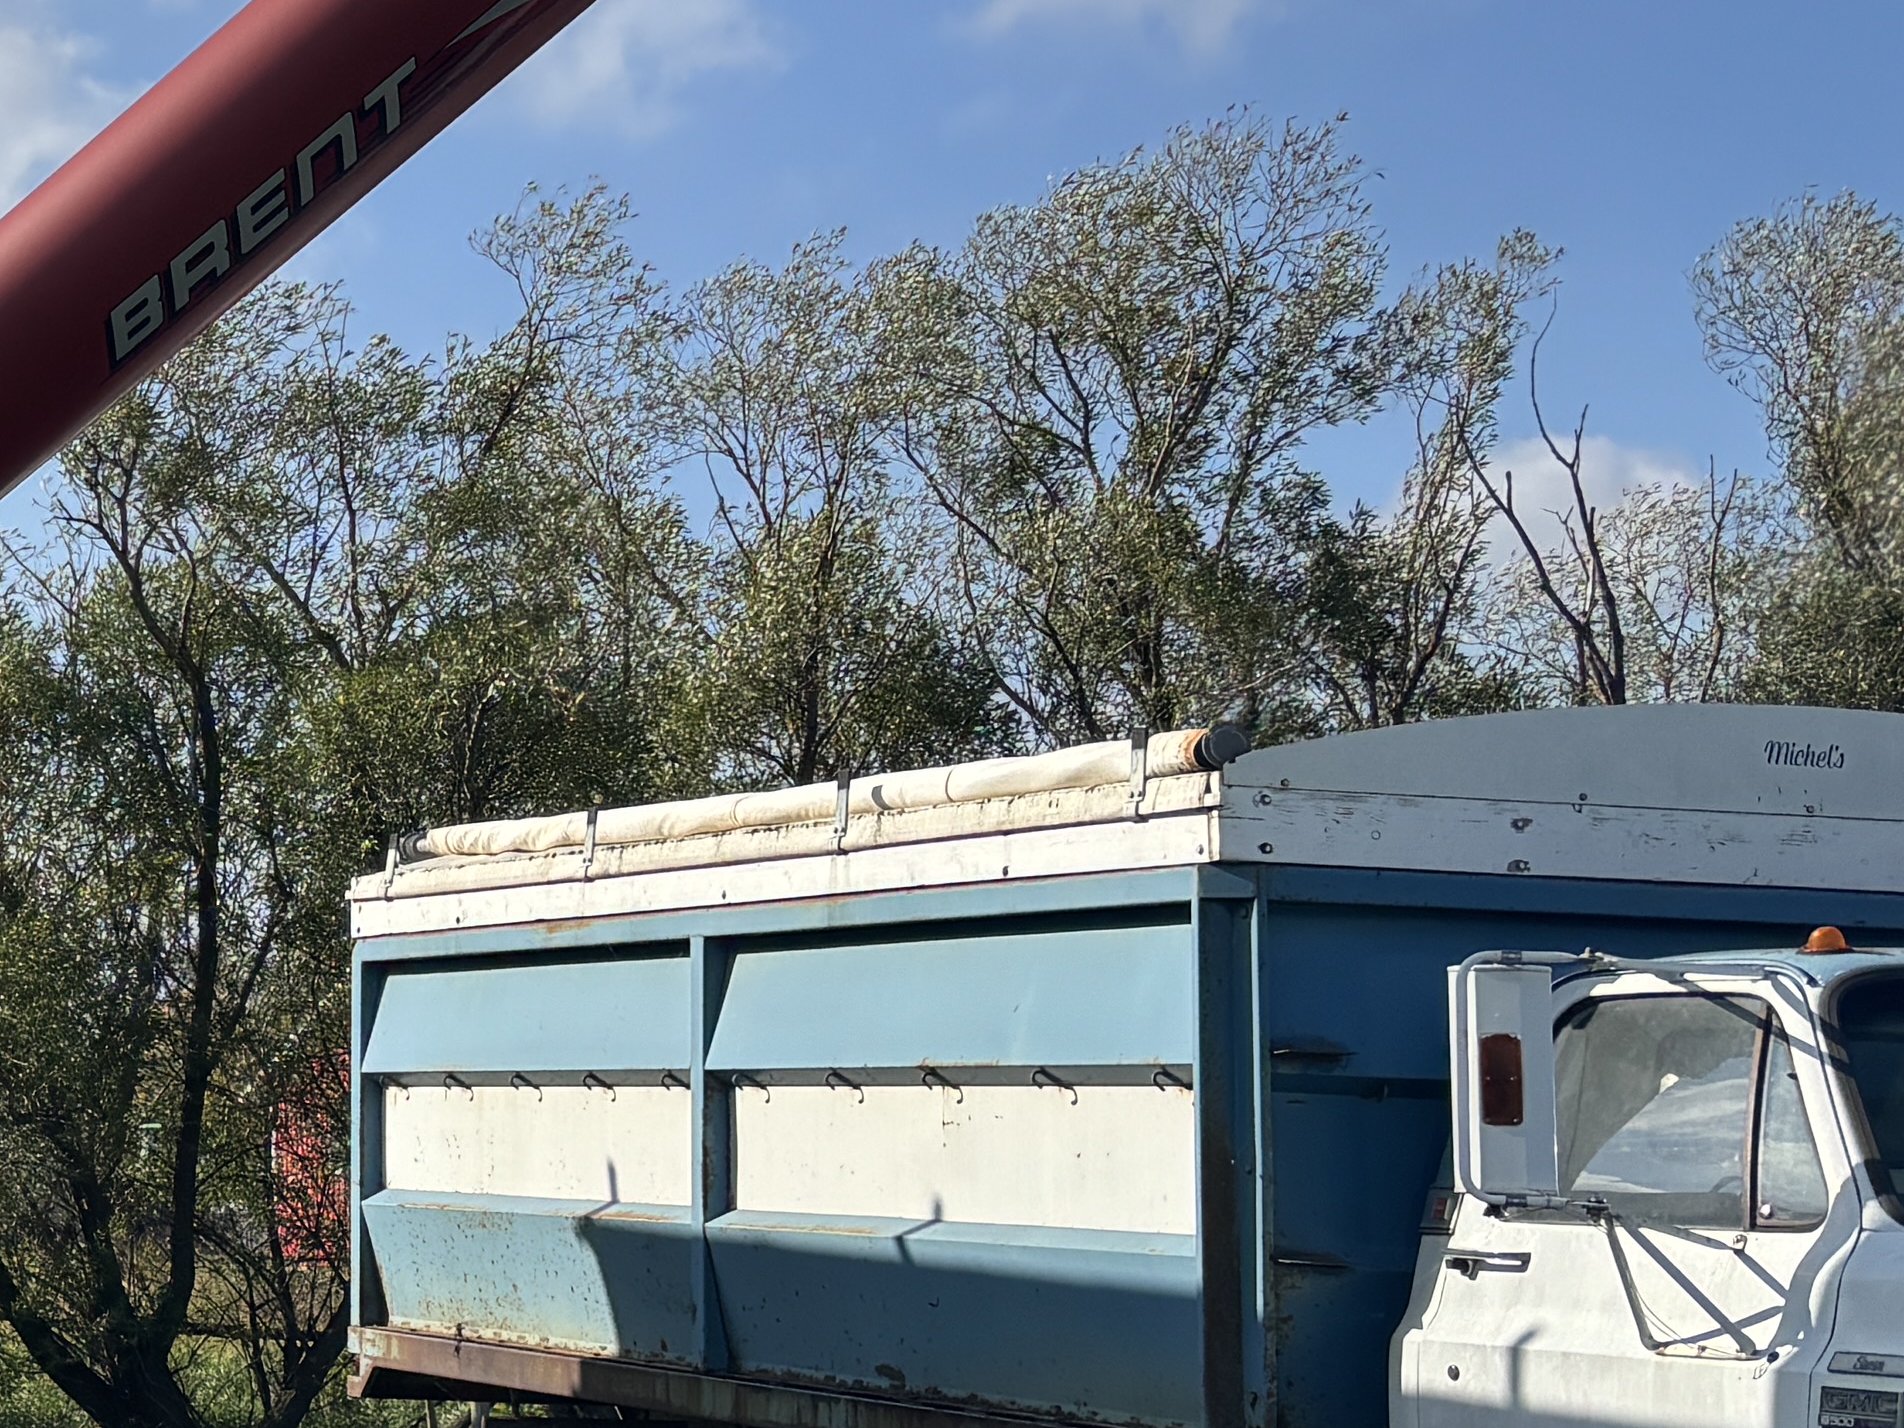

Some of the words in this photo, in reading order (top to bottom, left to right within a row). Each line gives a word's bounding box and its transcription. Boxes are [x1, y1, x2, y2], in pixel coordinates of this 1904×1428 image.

[109, 56, 417, 361] BRENT
[1764, 740, 1845, 769] Michel's
[1824, 1392, 1898, 1414] GMC
